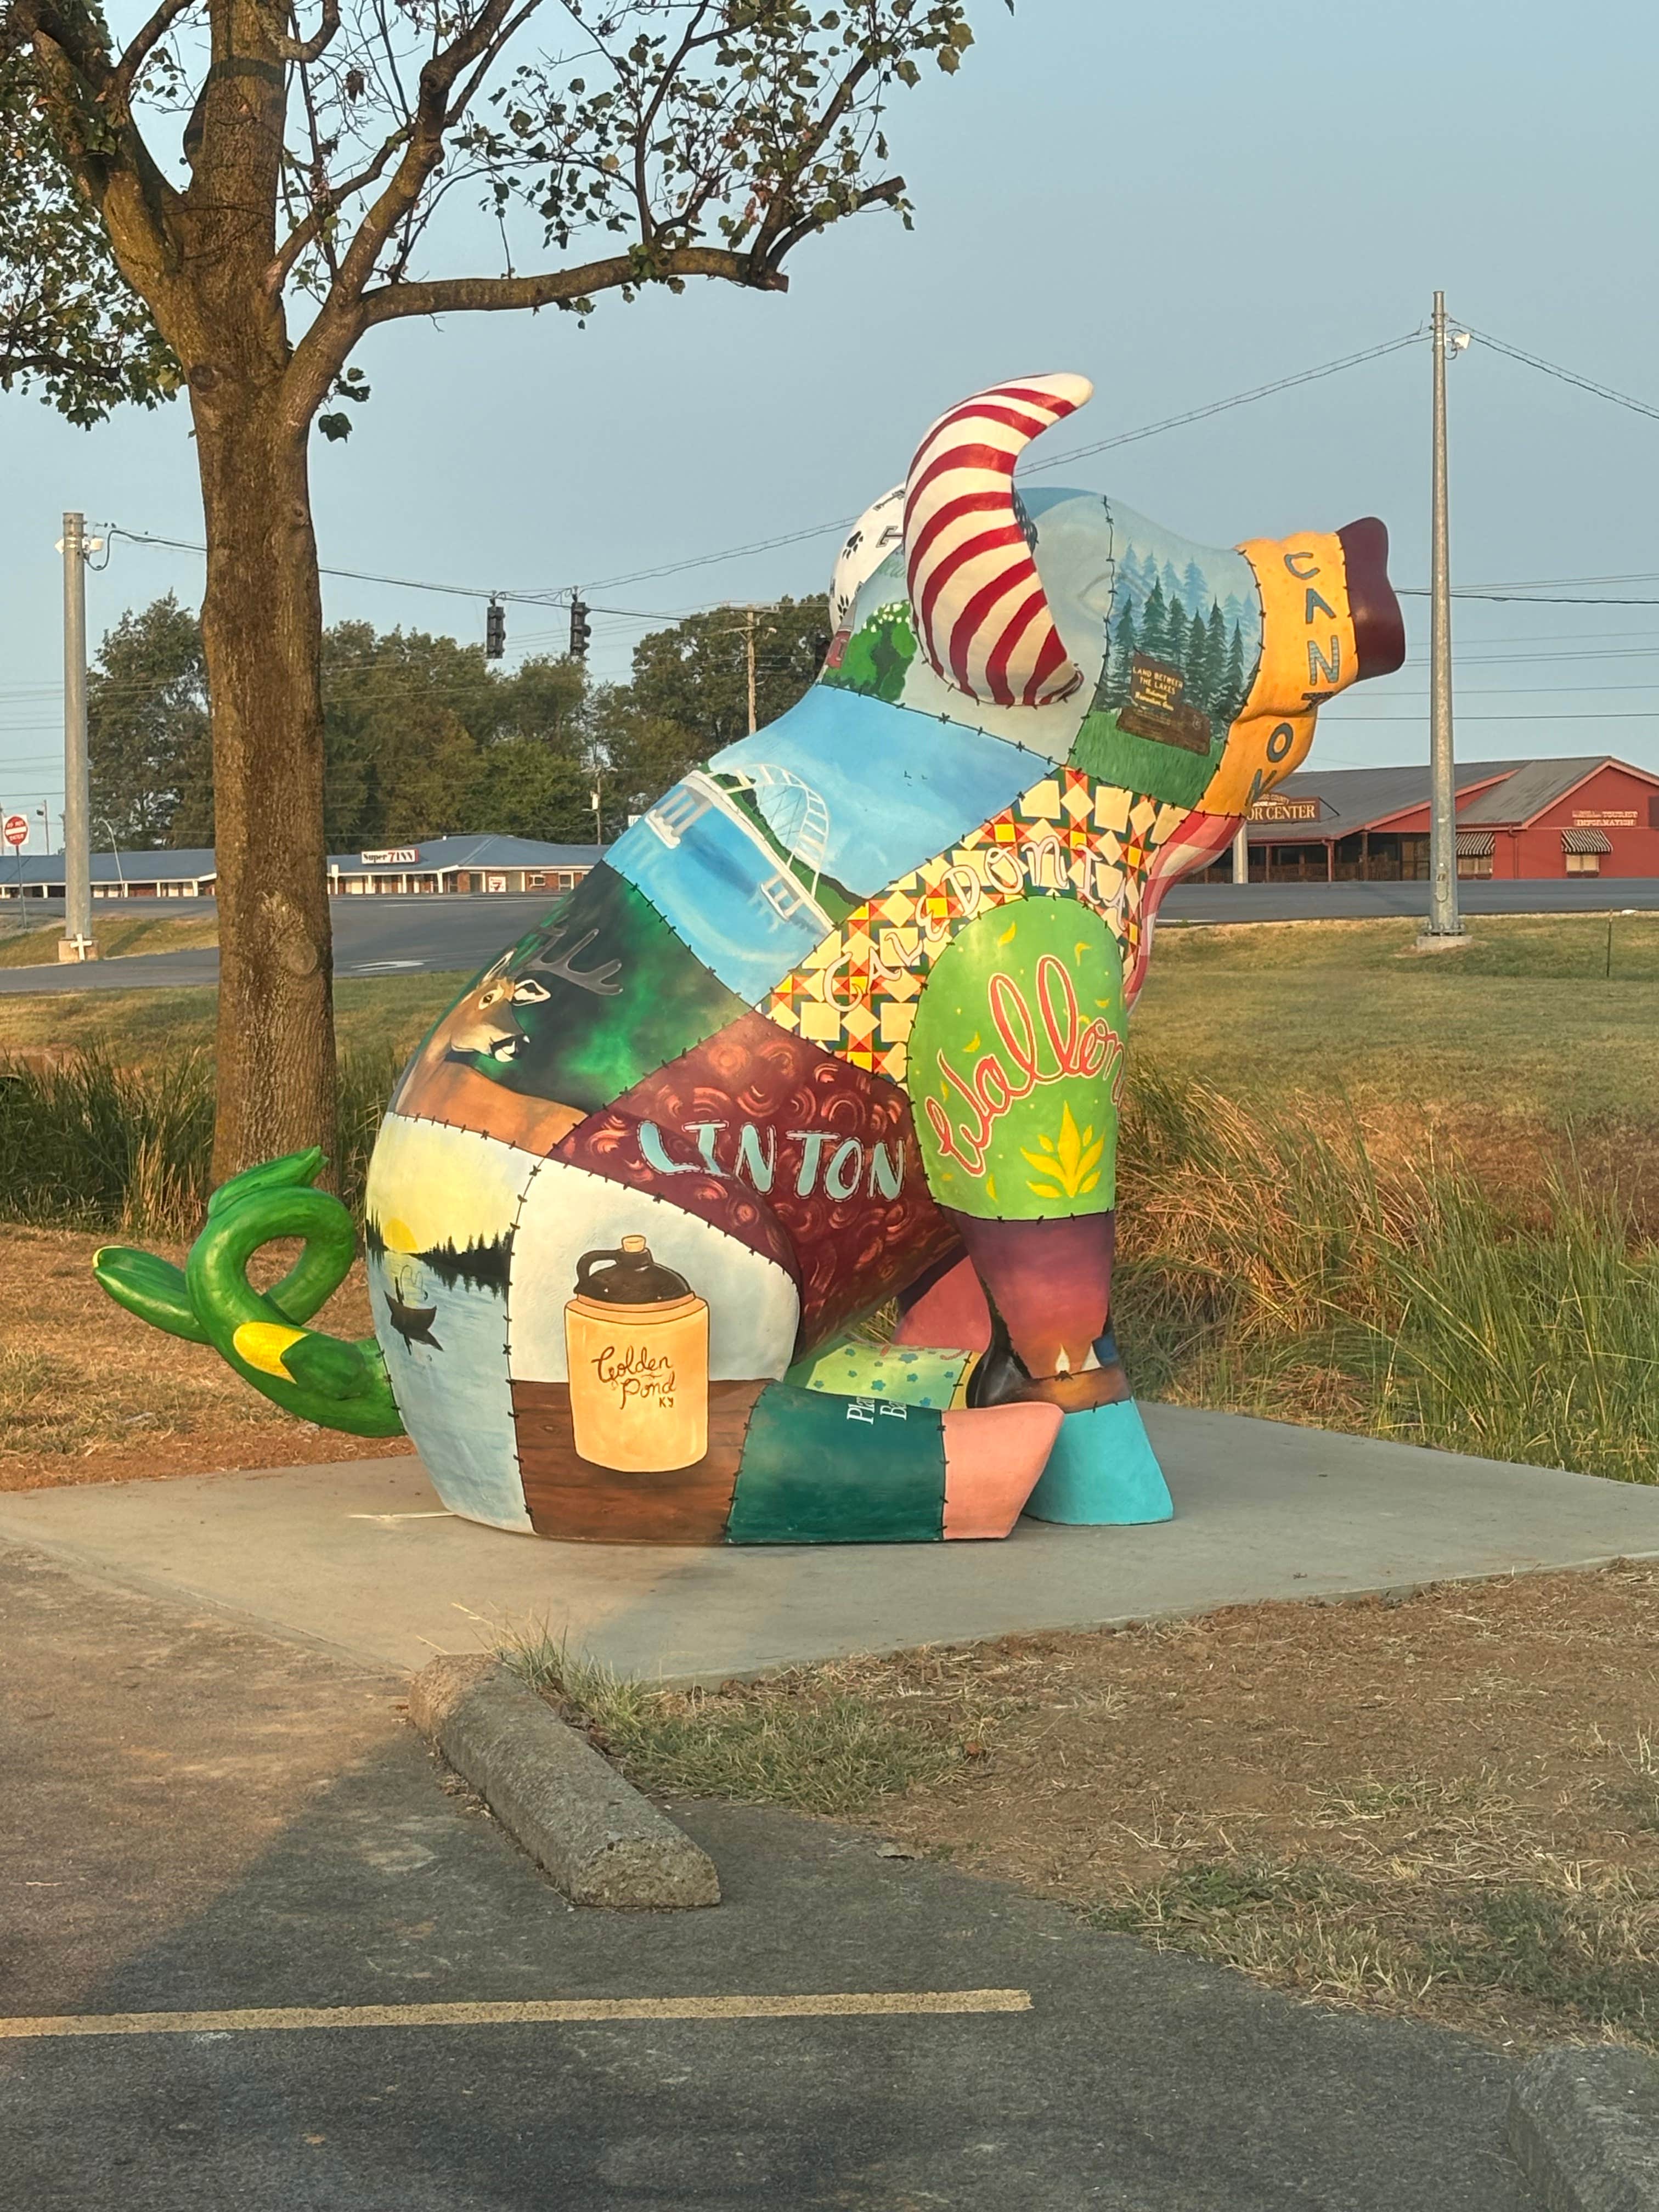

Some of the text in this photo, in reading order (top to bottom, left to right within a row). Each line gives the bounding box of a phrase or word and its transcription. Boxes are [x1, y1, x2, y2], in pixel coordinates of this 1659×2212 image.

[1133, 667, 1183, 689] LAND BETWEEN
[1140, 677, 1175, 695] THE LAKES
[1266, 805, 1316, 820] CENTER
[363, 853, 387, 863] Super
[387, 852, 396, 862] 7
[637, 1120, 905, 1203] LINTON
[591, 1345, 674, 1384] Golden
[620, 1370, 676, 1410] Pond
